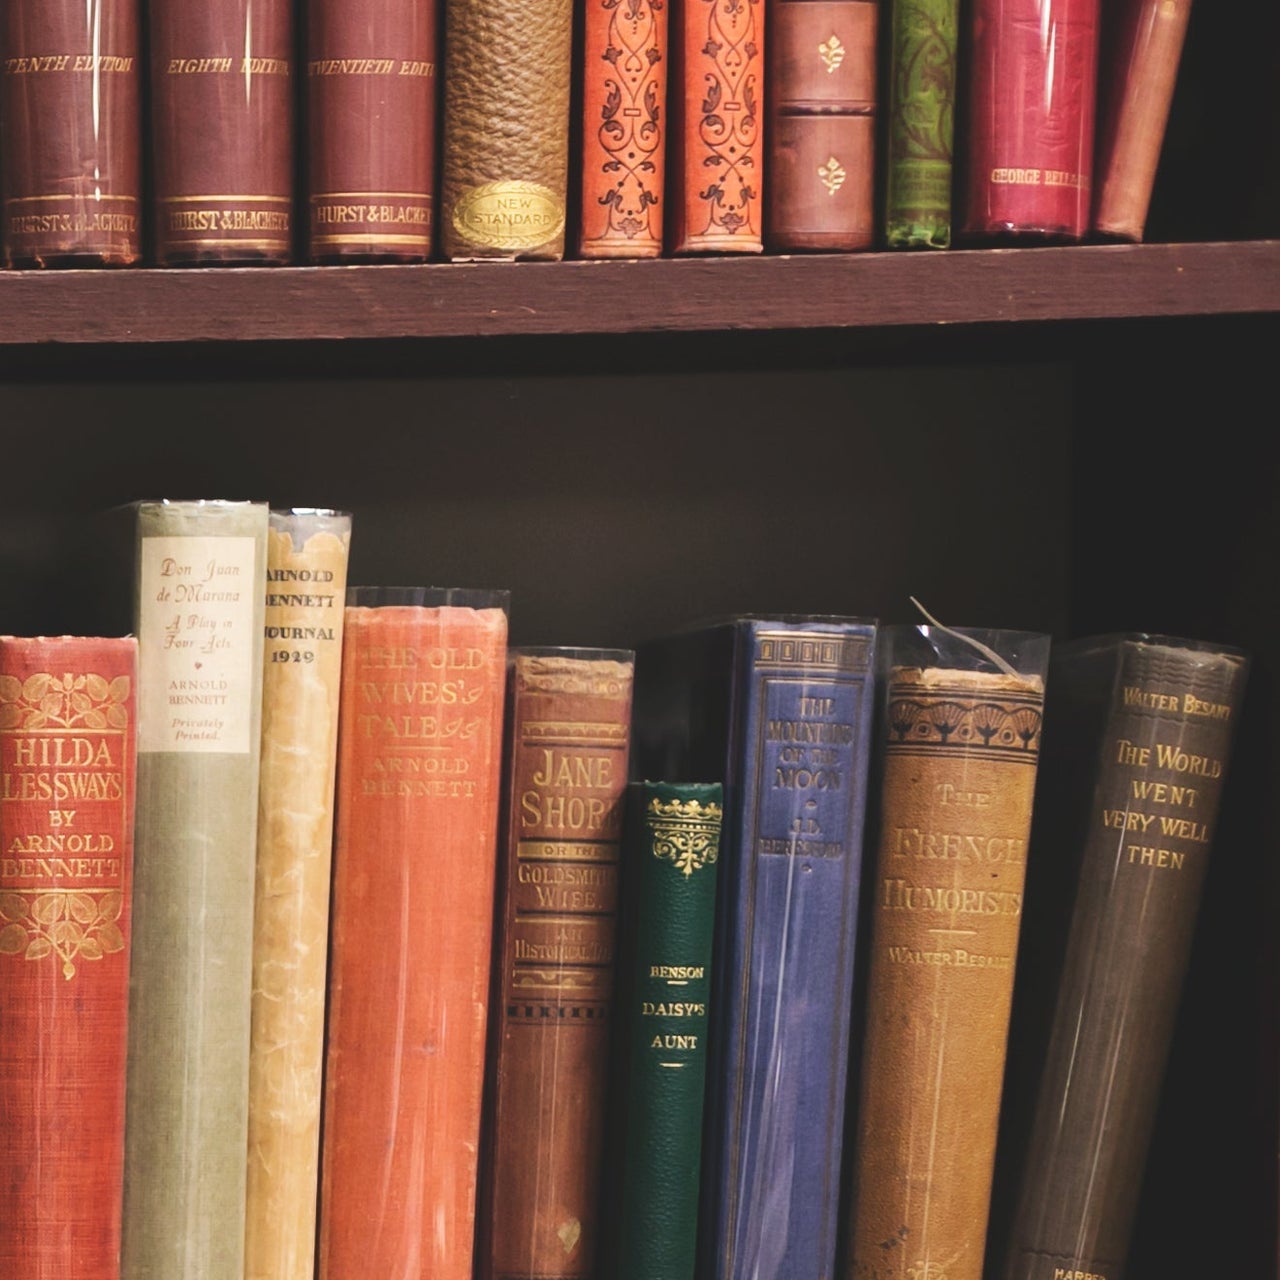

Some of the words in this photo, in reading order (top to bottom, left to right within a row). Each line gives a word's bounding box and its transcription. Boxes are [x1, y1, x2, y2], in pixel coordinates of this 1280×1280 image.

[5, 55, 68, 73] TENTH
[168, 58, 232, 74] EIGHTH
[309, 59, 394, 76] TWENTIETH
[991, 168, 1042, 186] GEORGE
[497, 198, 532, 210] NEW
[474, 212, 552, 225] STANDARD
[161, 558, 192, 577] Don
[271, 651, 314, 663] 1929
[169, 680, 228, 690] ARNOLD
[169, 695, 227, 706] BENNETT
[357, 715, 439, 739] TALE
[13, 738, 116, 767] HILDA
[534, 750, 614, 789] JANE
[2, 772, 122, 801] LESSWAYS
[1132, 781, 1199, 808] WENT
[49, 809, 76, 827] BY
[1103, 810, 1155, 832] VERY
[1160, 817, 1209, 843] WELL
[8, 834, 114, 853] ARNOLD
[894, 828, 1024, 865] FRENCH
[1128, 845, 1184, 870] THEN
[1, 858, 119, 879] BENNETT
[884, 878, 1022, 916] HUMORISTS
[650, 966, 704, 978] BENSON
[642, 1002, 705, 1017] DAISY'S
[651, 1036, 698, 1049] AUNT
